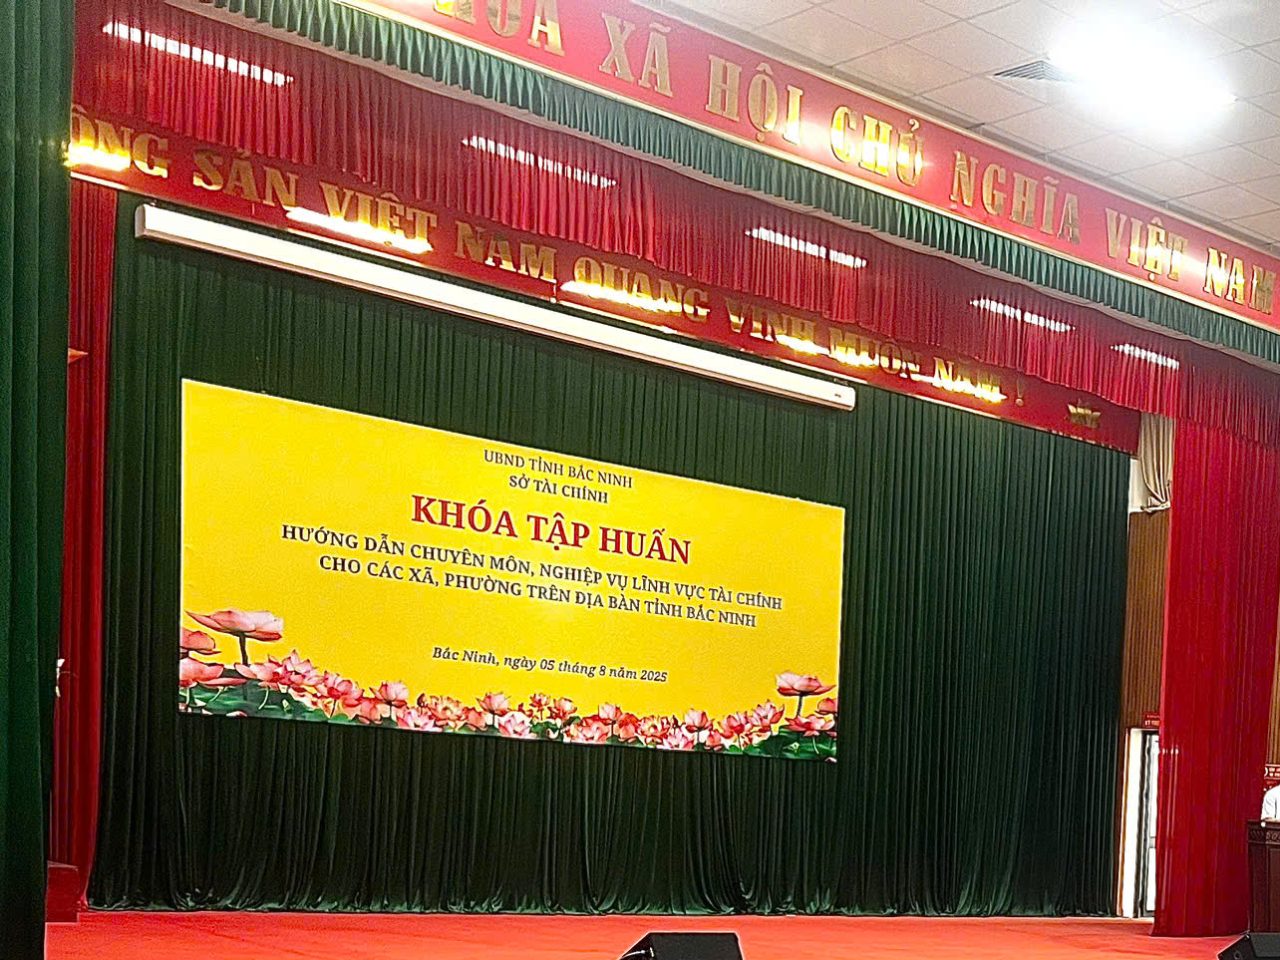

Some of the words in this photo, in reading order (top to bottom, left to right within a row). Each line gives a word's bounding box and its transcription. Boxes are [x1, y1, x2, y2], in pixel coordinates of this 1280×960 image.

[599, 12, 674, 98] XÃ
[705, 54, 804, 145] HỘI
[831, 105, 925, 188] CHỦ
[950, 149, 1082, 243] NGHĨA
[1104, 207, 1189, 282] VIỆT
[1203, 246, 1277, 315] NAM
[193, 148, 299, 209] SẢN
[319, 181, 437, 252] VIỆT
[455, 220, 557, 283] NAM
[574, 256, 711, 322] QUANG
[829, 326, 922, 378] MUÔN
[484, 449, 525, 468] UBND
[529, 455, 564, 476] TỈNH
[598, 470, 633, 489] NINH
[509, 474, 530, 489] SỞ
[533, 477, 557, 495] TÀI
[561, 483, 608, 504] CHÍNH
[411, 494, 518, 538] KHÓA
[527, 511, 590, 551] TẬP
[599, 526, 691, 564] HUẤN
[281, 524, 358, 549] HƯỚNG
[364, 533, 405, 556] DẪN
[410, 544, 485, 567] CHUYÊN
[489, 553, 535, 577] MÔN,
[539, 562, 602, 587] NGHIỆP
[606, 573, 628, 589] VỤ
[632, 574, 670, 595] LĨNH
[674, 584, 705, 600] VỰC
[708, 586, 732, 603] TÀI
[736, 591, 782, 610] CHÍNH
[319, 555, 361, 573] CHO
[367, 561, 403, 580] CÁC
[408, 567, 439, 587] XÃ,
[444, 572, 522, 596] PHƯỜNG
[526, 583, 570, 603] TRÊN
[575, 590, 604, 610] ĐỊA
[608, 594, 640, 612] BÀN
[644, 597, 682, 618] TỈNH
[718, 611, 756, 628] NINH
[462, 650, 499, 667] Ninh,
[503, 656, 536, 671] ngày
[540, 658, 555, 671] 05
[558, 660, 596, 677] tháng
[598, 665, 606, 676] 8
[609, 666, 637, 680] năm
[640, 670, 667, 682] 2025
